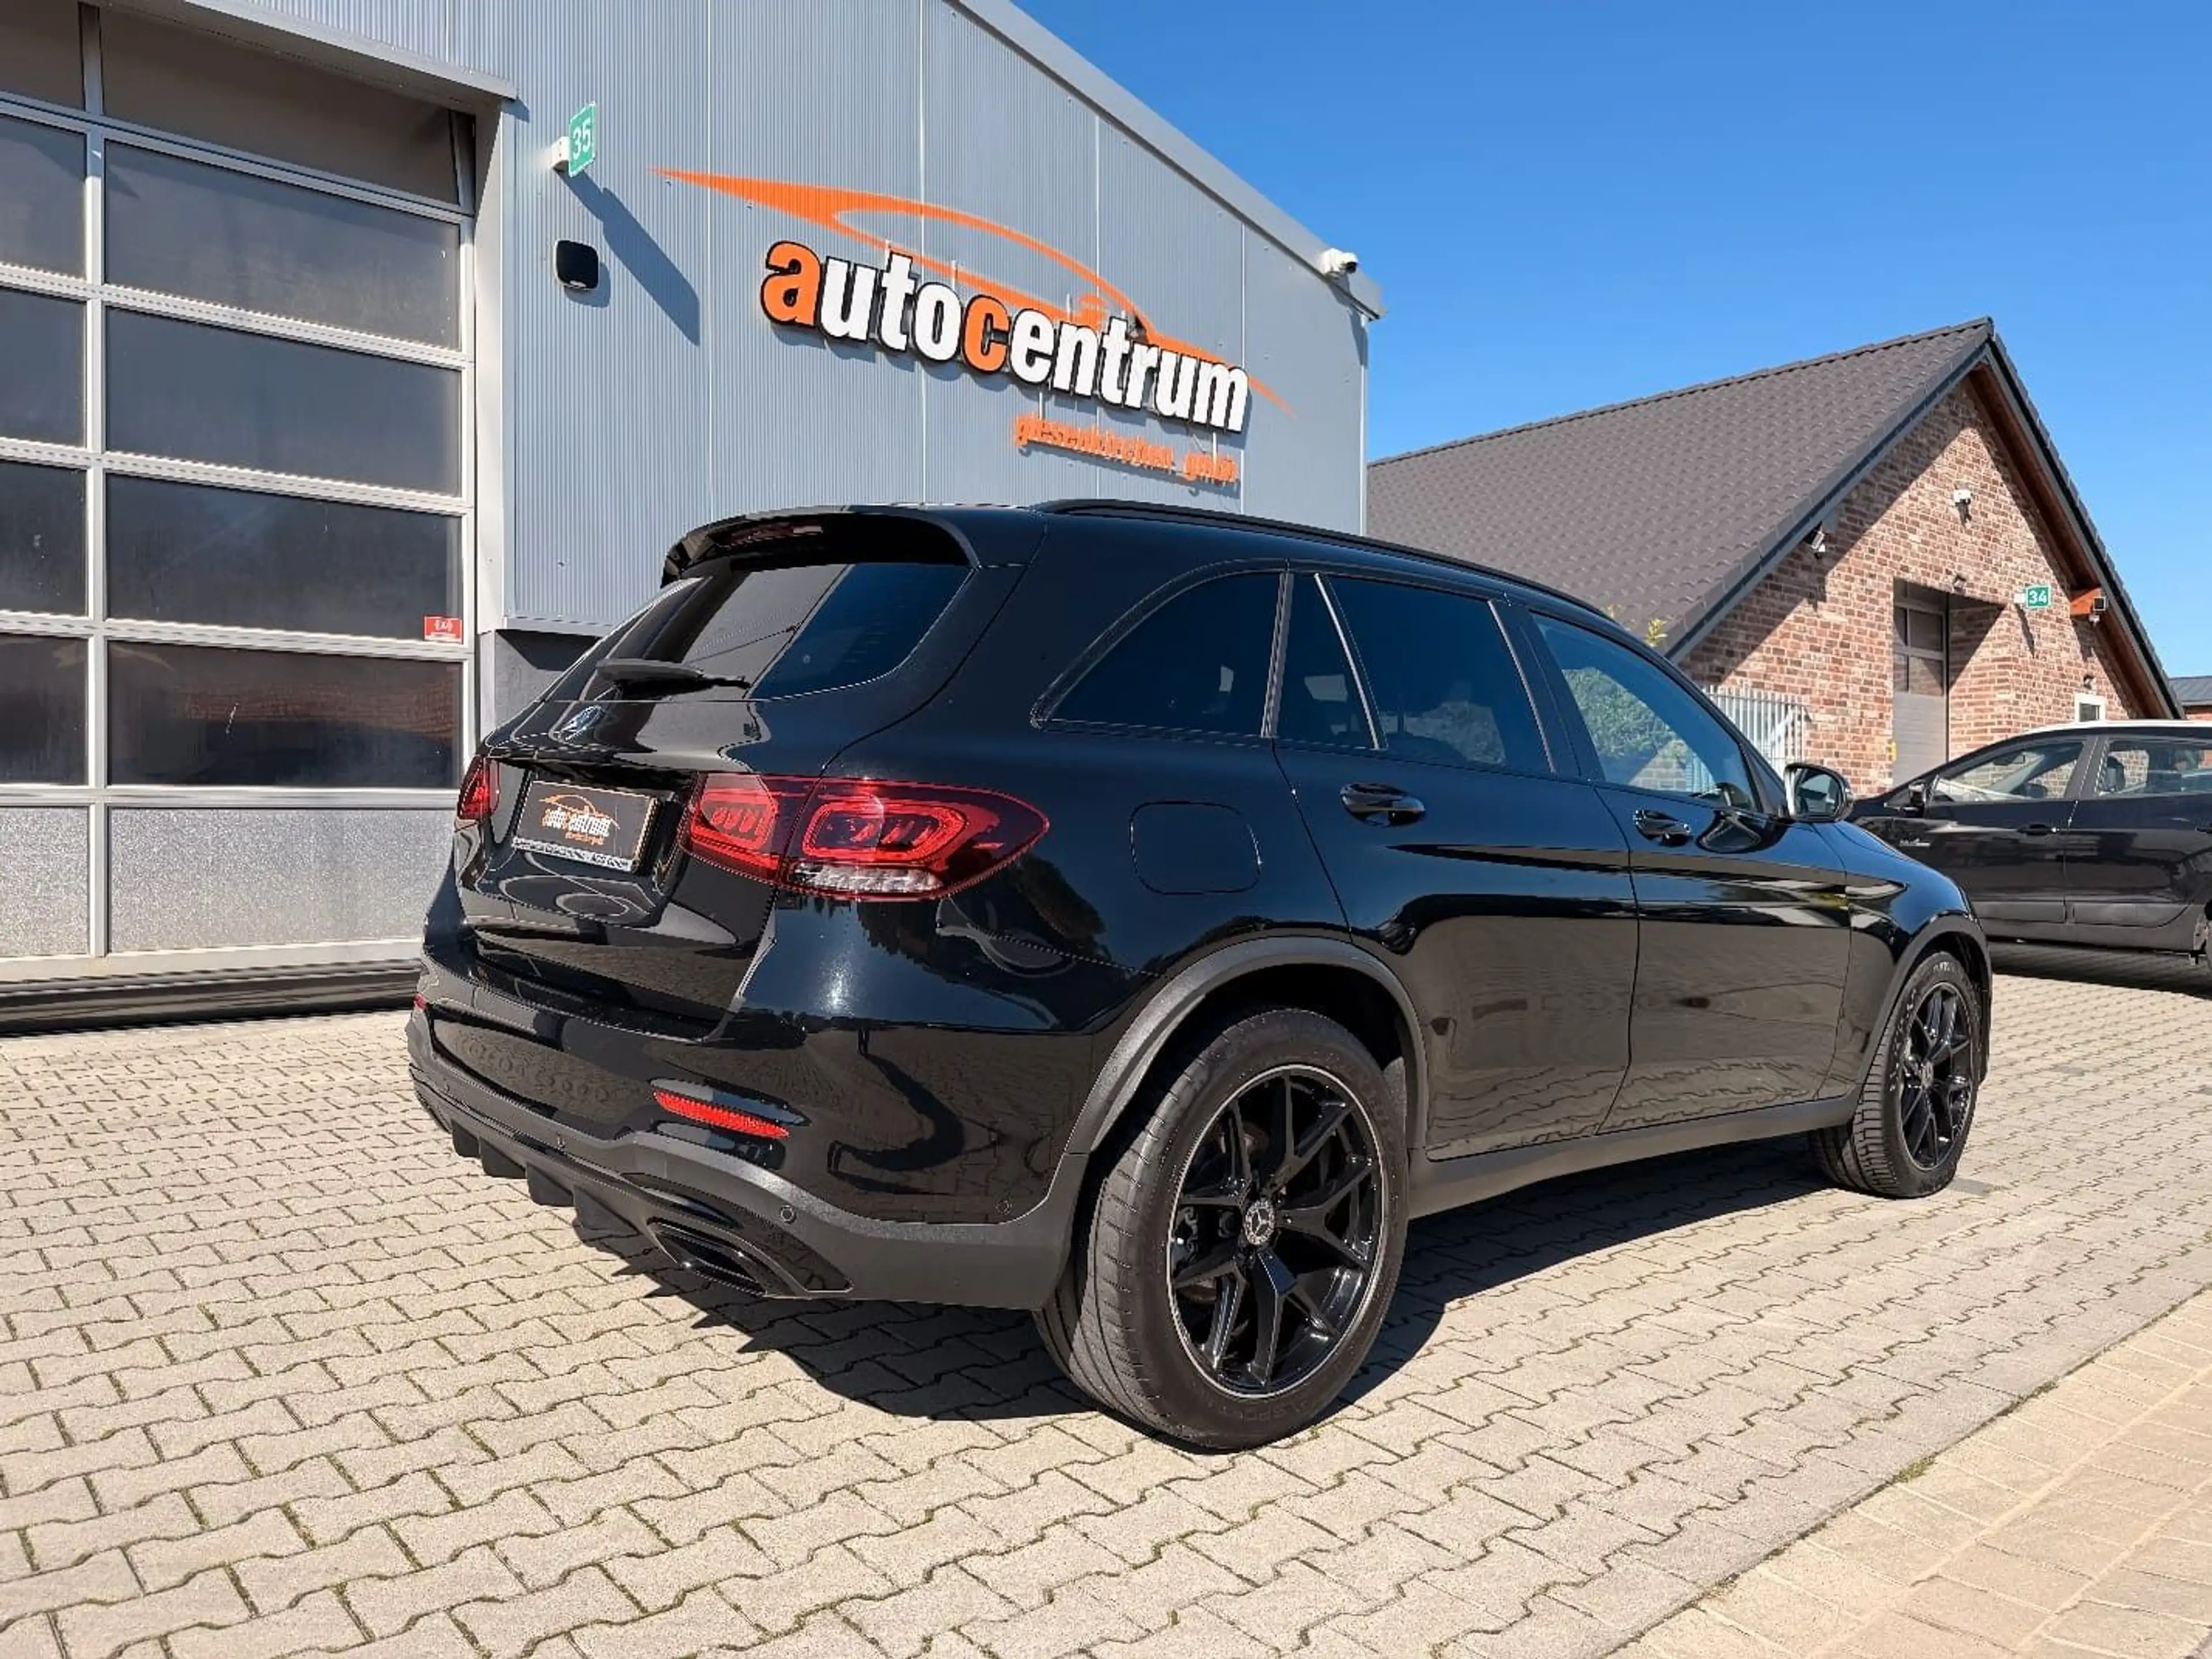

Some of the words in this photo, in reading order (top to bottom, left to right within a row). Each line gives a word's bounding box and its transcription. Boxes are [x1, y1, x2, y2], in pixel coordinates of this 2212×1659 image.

[573, 117, 591, 160] 35
[760, 239, 1249, 433] autocentrum
[2028, 590, 2047, 604] 34
